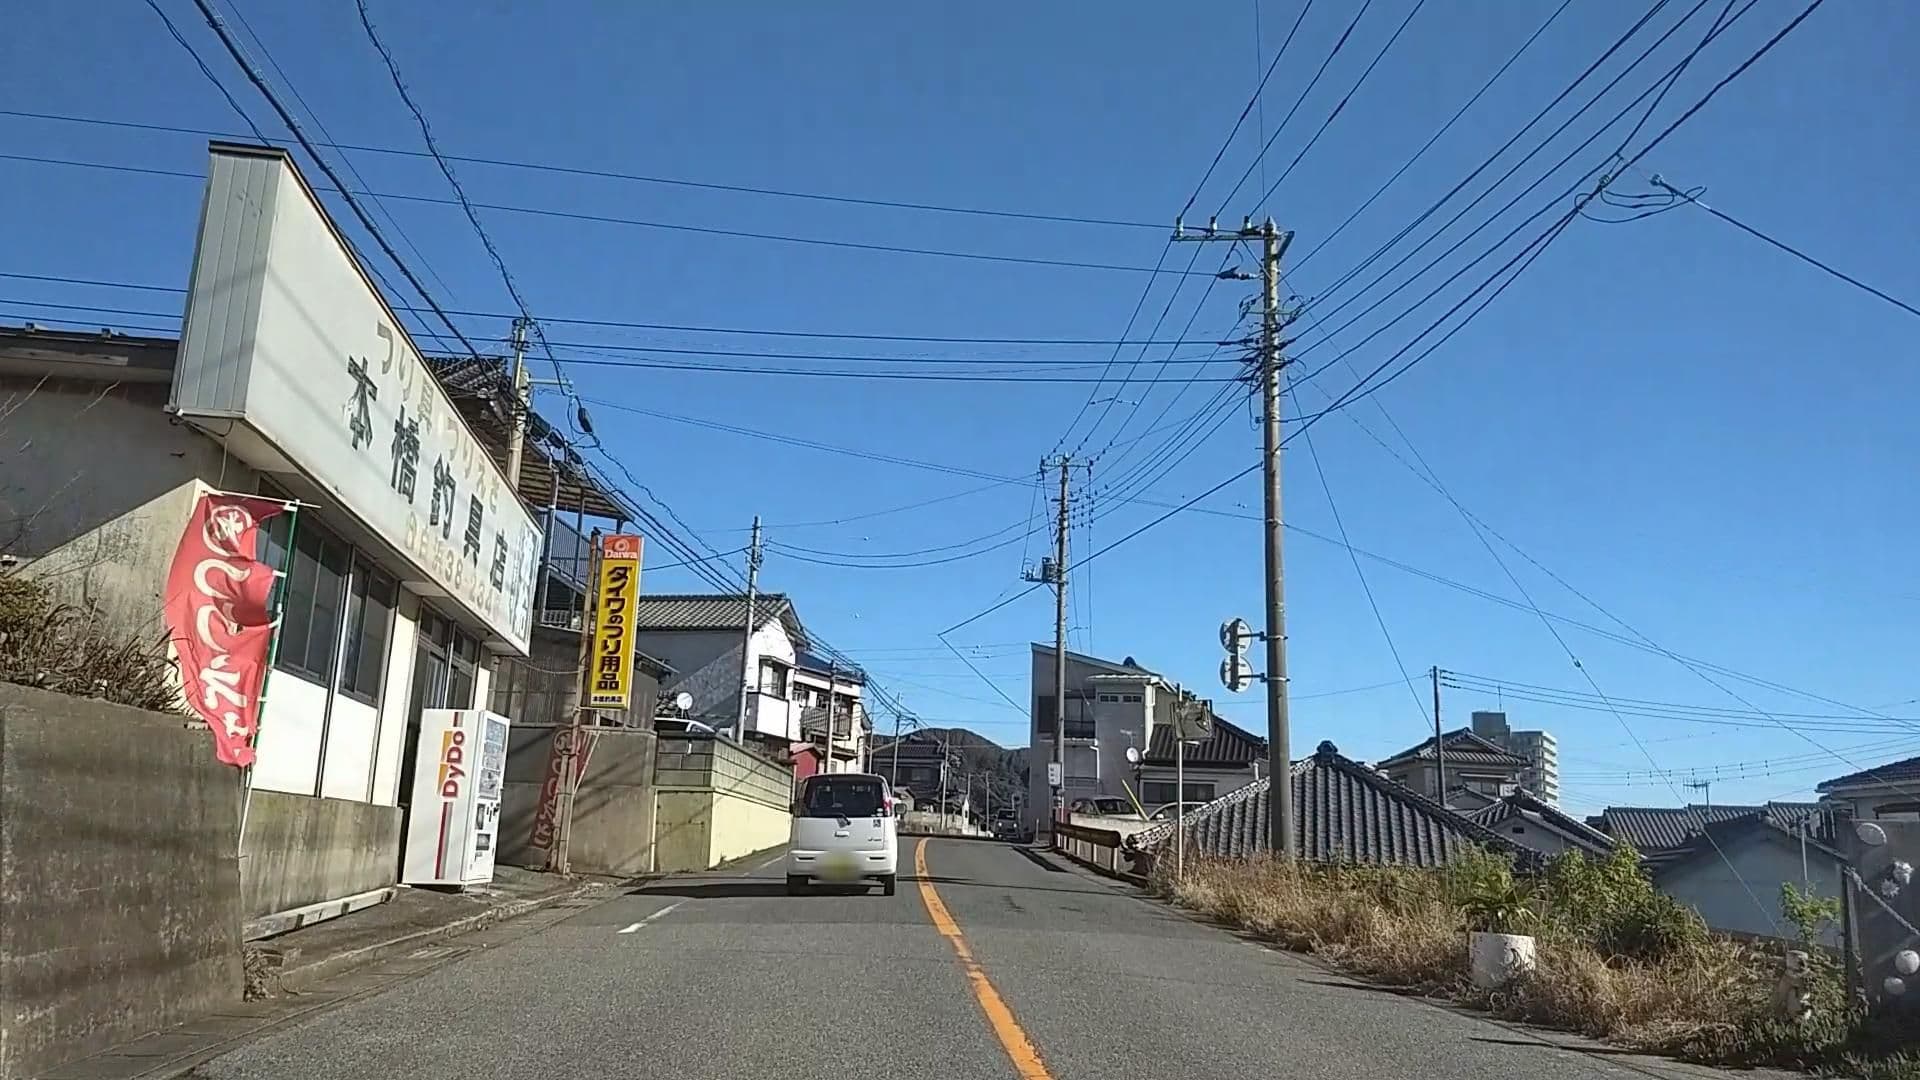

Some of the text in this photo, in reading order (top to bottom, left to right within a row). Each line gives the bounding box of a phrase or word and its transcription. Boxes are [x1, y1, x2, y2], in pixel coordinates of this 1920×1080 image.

[346, 354, 508, 593] 本橋釣具店
[604, 549, 638, 559] Daiwa
[598, 566, 632, 690] ダイワのつり用品
[442, 730, 466, 798] DyDo
